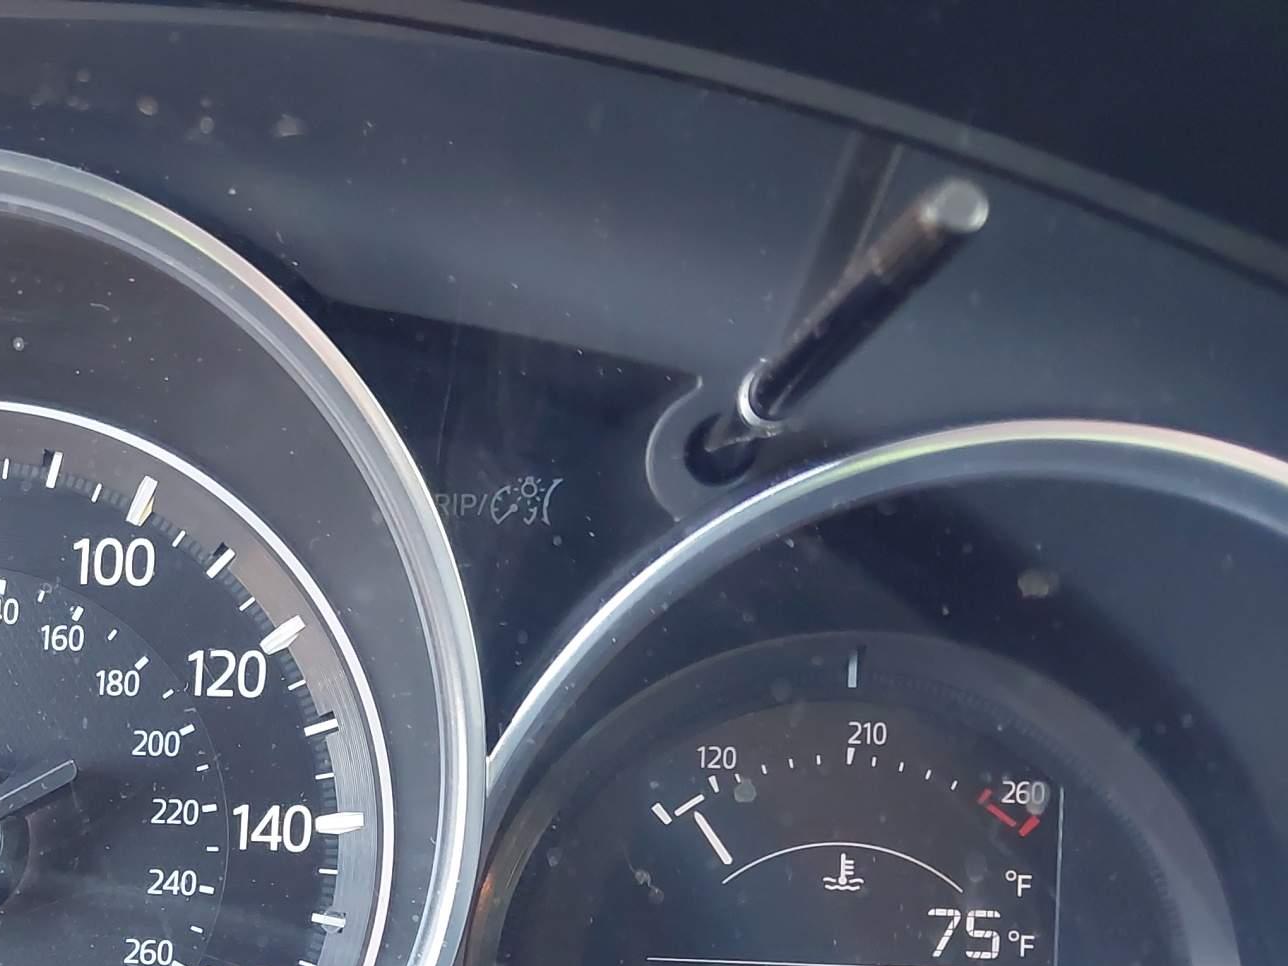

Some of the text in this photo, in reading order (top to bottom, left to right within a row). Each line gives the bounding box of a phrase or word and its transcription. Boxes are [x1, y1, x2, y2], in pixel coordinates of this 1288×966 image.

[434, 491, 488, 517] RIP/
[73, 537, 155, 587] 100
[40, 624, 85, 652] 160
[96, 669, 140, 697] 180
[187, 647, 269, 698] 120
[131, 730, 181, 757] 200
[847, 721, 887, 745] 210
[697, 746, 737, 770] 120
[1001, 780, 1045, 805] 260
[150, 798, 199, 826] 220
[232, 804, 312, 853] 140
[147, 868, 197, 896] 240
[1005, 870, 1033, 897] °F
[927, 908, 1035, 959] 75 °F
[123, 938, 173, 966] 260
